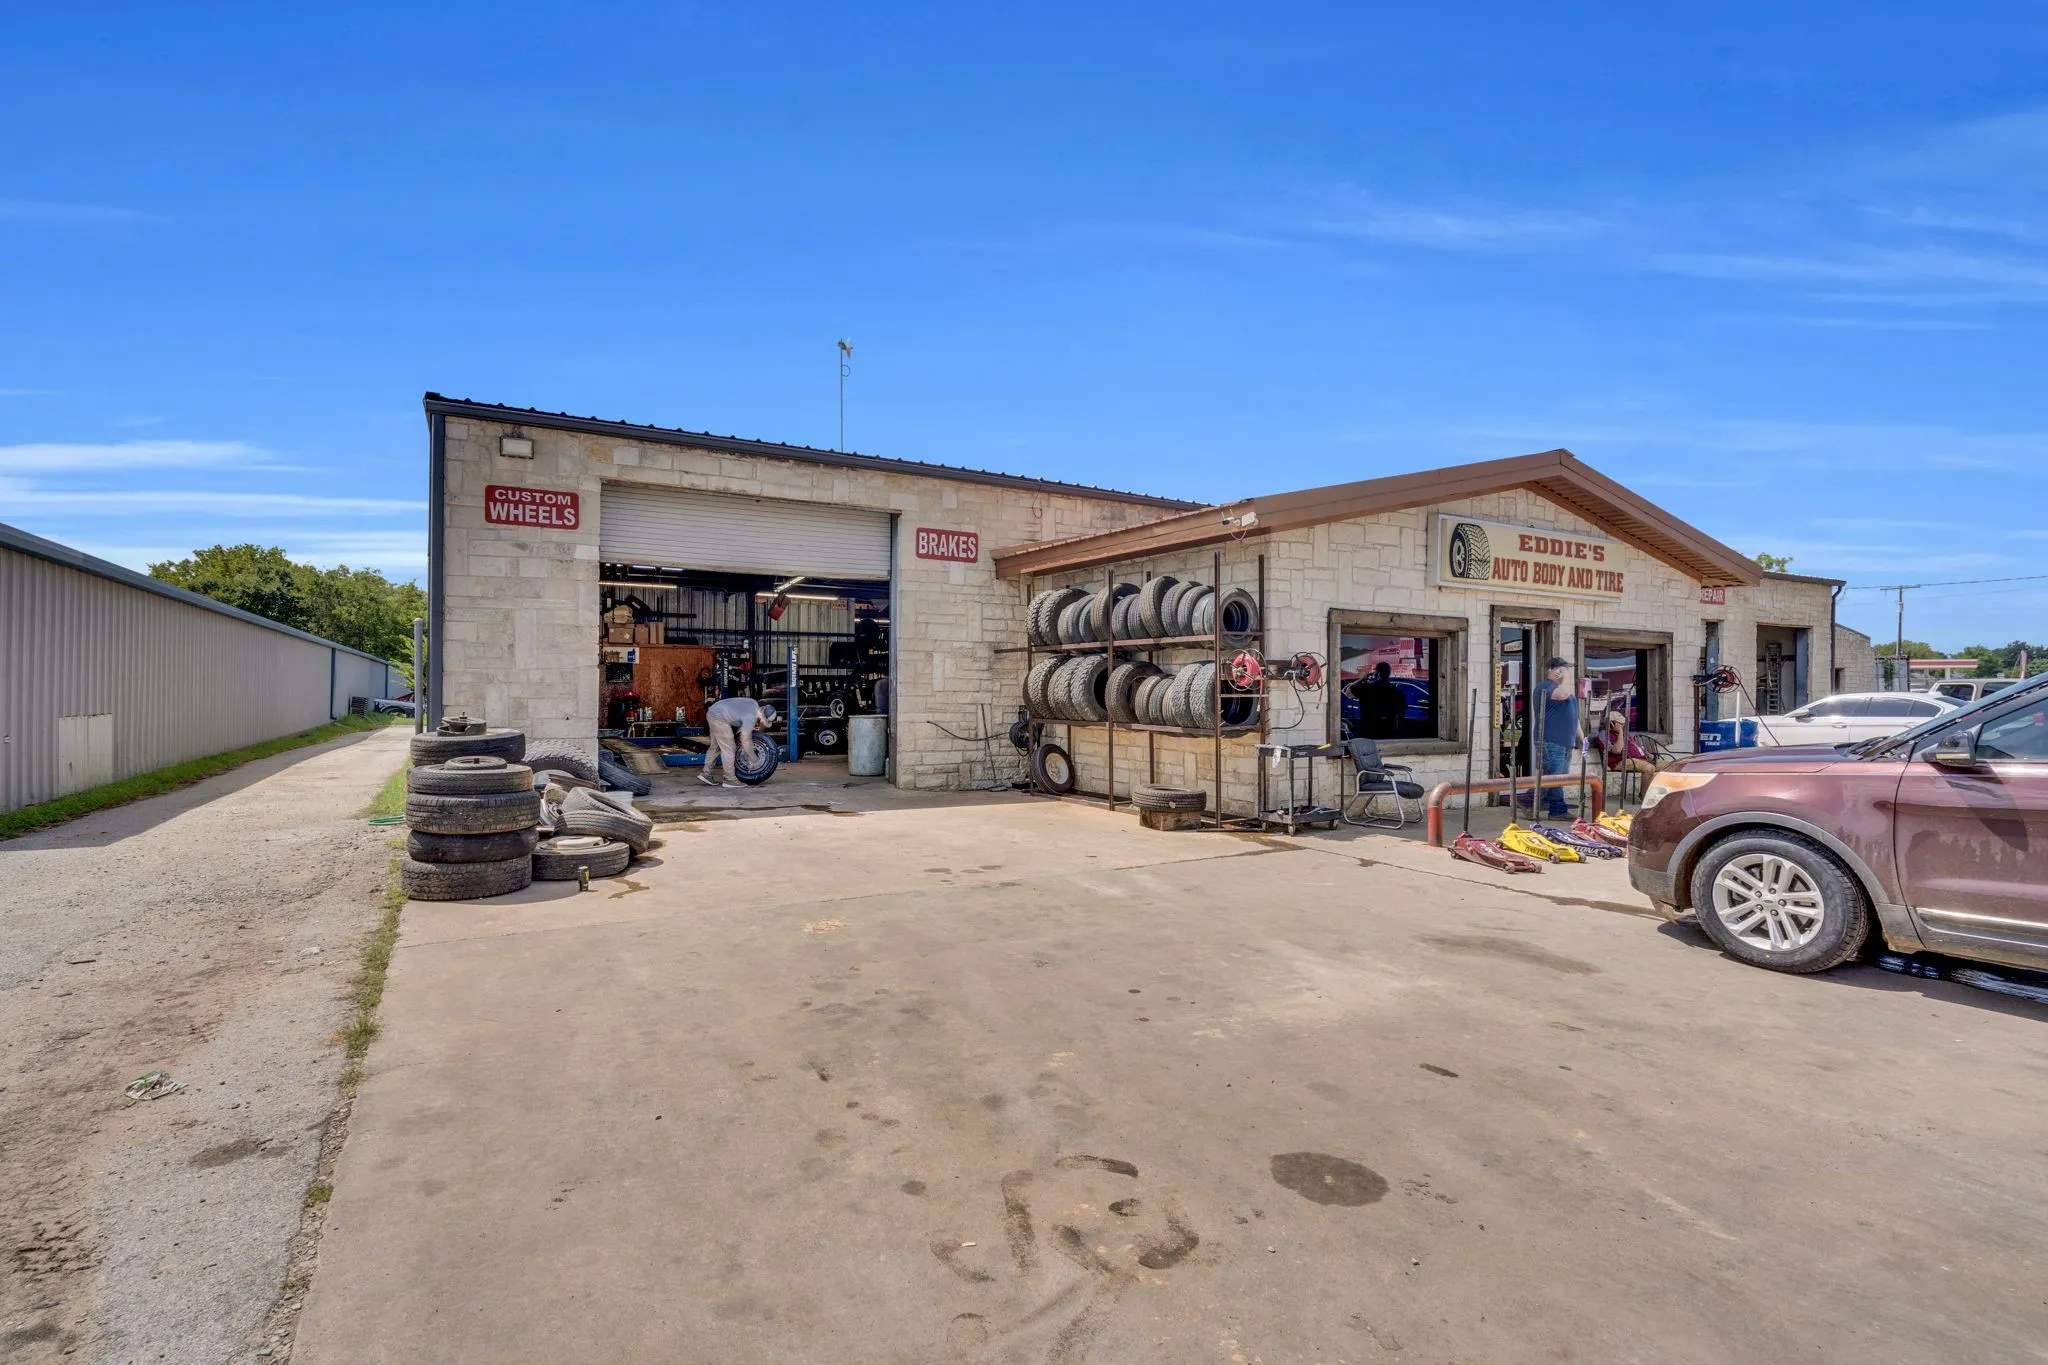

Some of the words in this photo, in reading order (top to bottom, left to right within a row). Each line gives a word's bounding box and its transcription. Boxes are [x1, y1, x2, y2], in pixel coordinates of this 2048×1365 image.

[494, 489, 571, 506] CUSTOM
[488, 501, 576, 526] WHEELS
[918, 532, 977, 559] BRAKES
[1518, 533, 1606, 562] EDDIE'S
[1491, 557, 1529, 583] AUTO
[1532, 561, 1566, 587] BODY
[1567, 566, 1594, 590] AND
[1595, 569, 1624, 594] TIRE
